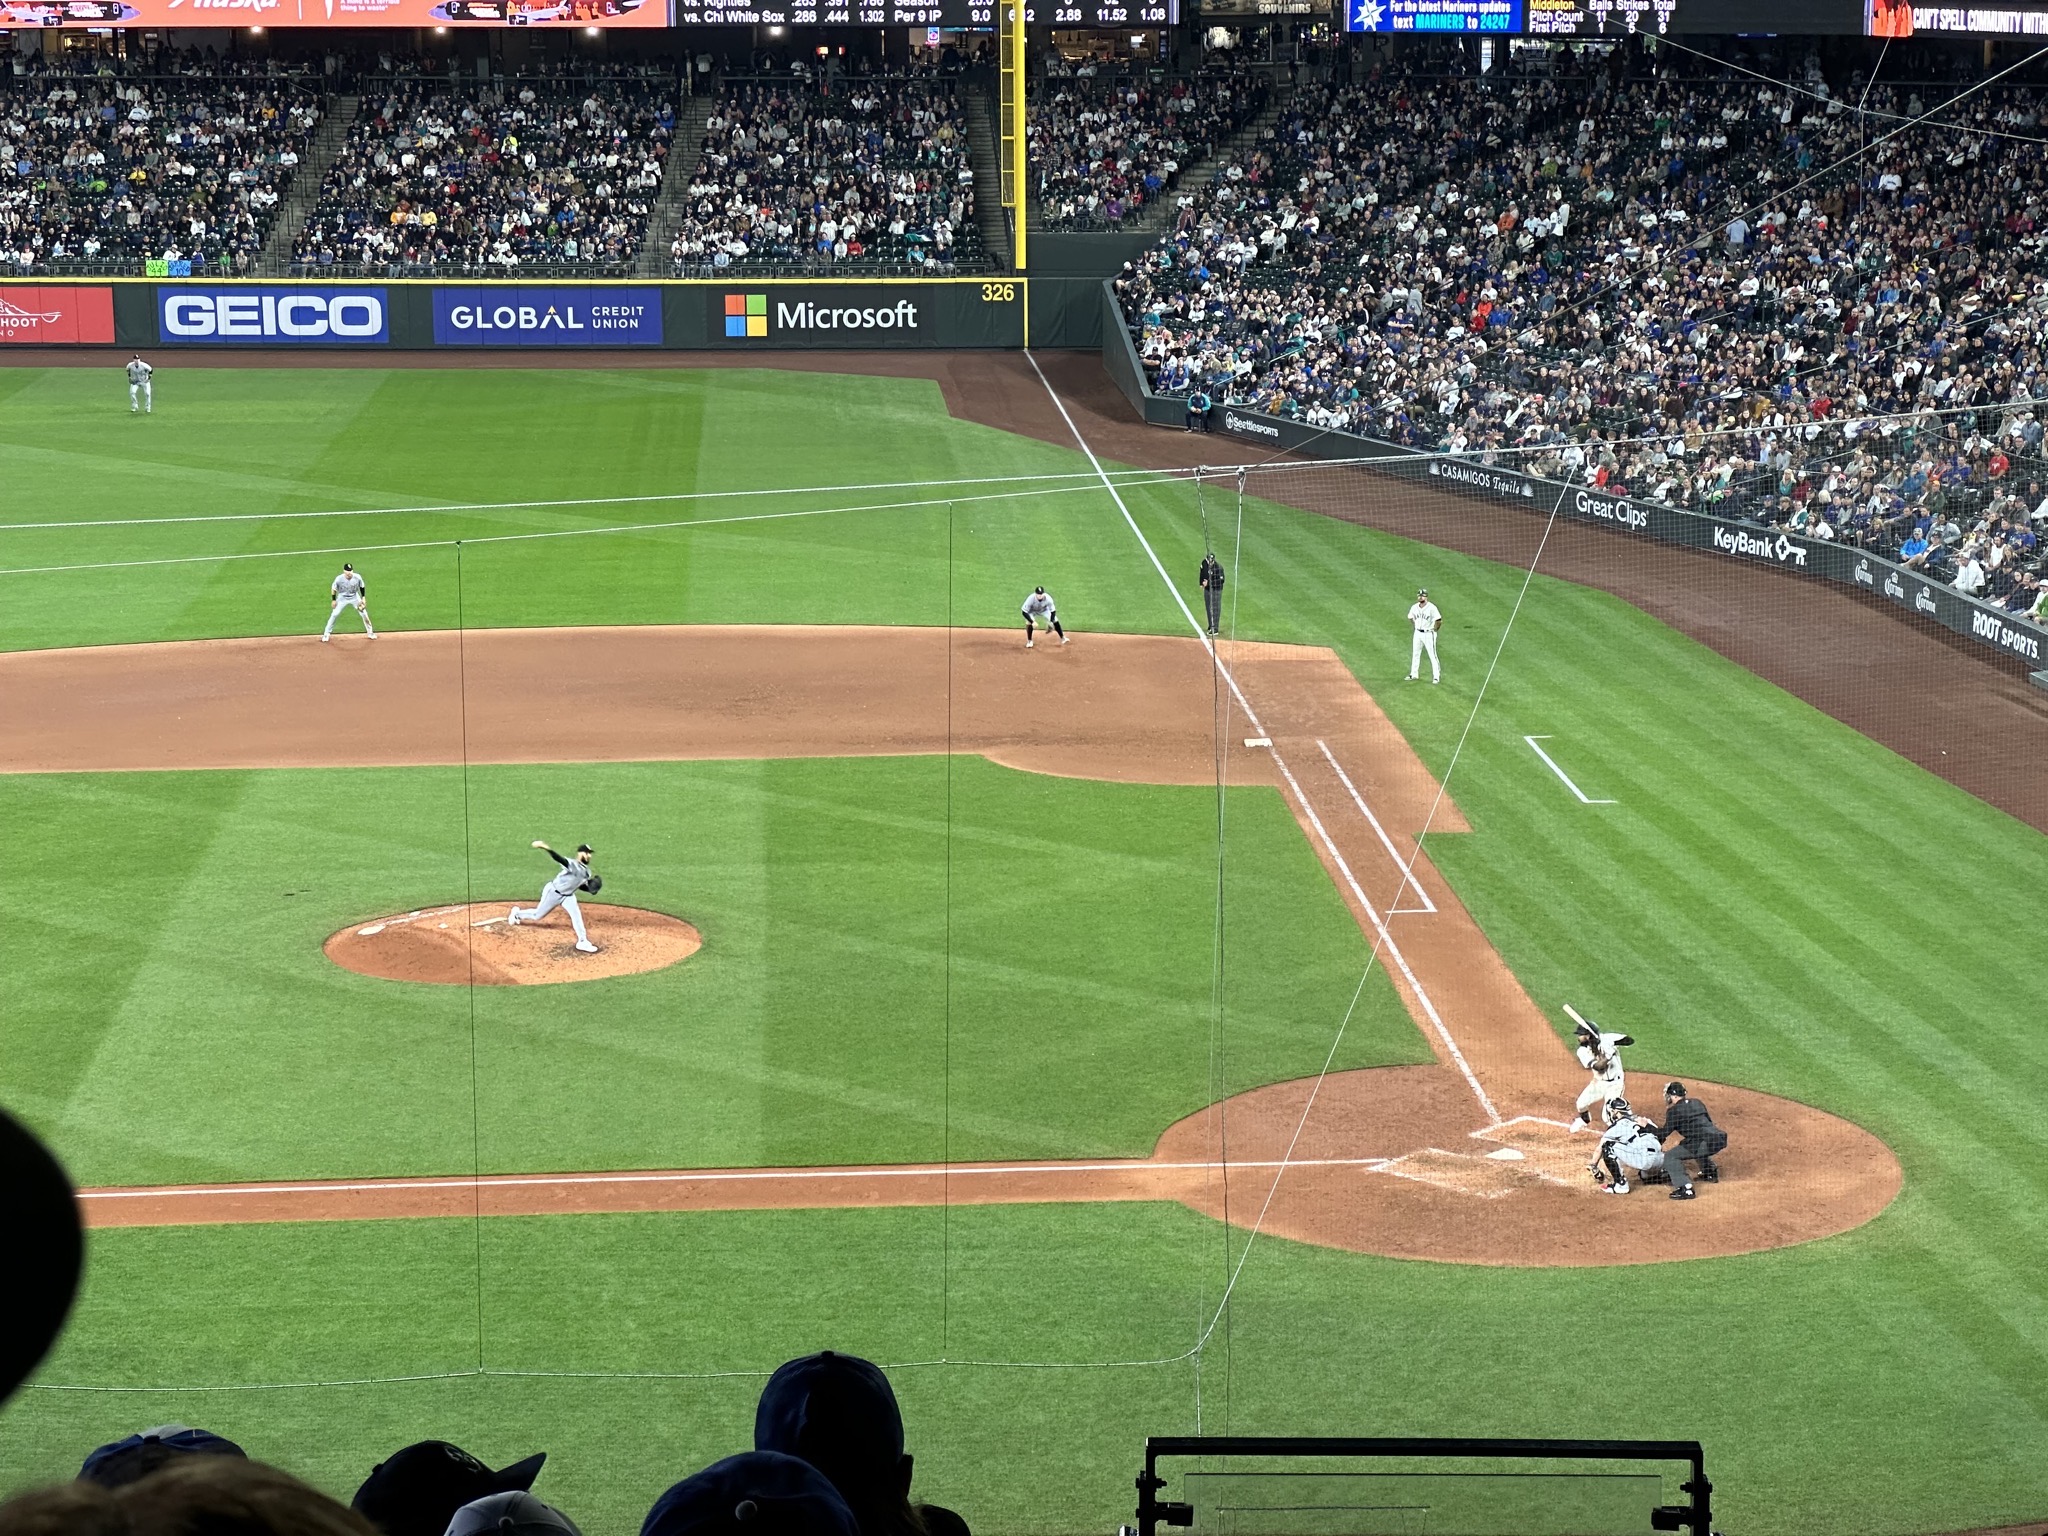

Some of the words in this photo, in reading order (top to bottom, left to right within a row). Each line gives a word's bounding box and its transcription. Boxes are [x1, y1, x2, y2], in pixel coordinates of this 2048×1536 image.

[1258, 3, 1311, 14] SOUVENIRS
[1390, 1, 1403, 12] For
[1404, 1, 1417, 12] the
[1418, 1, 1441, 12] latest
[1442, 2, 1478, 13] Mariners
[1479, 2, 1511, 15] updates
[1529, 0, 1575, 10] Middleton
[1589, 0, 1613, 10] Balls
[1616, 0, 1650, 10] Strikes
[1653, 0, 1677, 10] Total
[684, 13, 701, 23] vs.
[704, 11, 725, 23] Chi
[726, 11, 760, 23] White
[762, 10, 785, 23] Sox
[791, 11, 817, 23] .286
[825, 11, 849, 22] .444
[859, 11, 885, 22] 1.302
[894, 11, 915, 22] Per
[917, 11, 926, 22] 9
[929, 11, 943, 22] IP
[971, 10, 991, 22] 9.0
[1055, 9, 1082, 21] 2.88
[1096, 9, 1127, 21] 11.52
[1140, 9, 1165, 21] 1.08
[1393, 15, 1414, 28] text
[1415, 14, 1465, 29] MARINERS
[1467, 16, 1478, 29] to
[1480, 14, 1510, 29] 24247
[1529, 10, 1553, 21] Pitch
[1555, 11, 1583, 22] Count
[1597, 11, 1607, 22] 11
[1626, 11, 1639, 22] 20
[1657, 11, 1670, 22] 31
[1913, 8, 1939, 30] CAN'T
[1939, 8, 1967, 31] SPELL
[1967, 9, 2022, 33] COMMUNITY
[2022, 11, 2048, 34] WITH
[1529, 21, 1550, 33] First
[1552, 21, 1576, 33] Pitch
[1598, 22, 1605, 33] 1
[1628, 22, 1636, 34] 5
[1658, 22, 1667, 34] 6
[151, 268, 163, 277] 44
[176, 268, 185, 276] 10
[981, 283, 1015, 302] 326
[164, 295, 383, 336] GEICO
[451, 305, 584, 329] GLOBAL
[592, 306, 644, 317] CREDIT
[777, 299, 918, 329] Microsoft
[592, 319, 639, 329] UNION
[1441, 463, 1491, 489] CASAMIGOS
[1492, 477, 1521, 496] Tequila
[1576, 490, 1613, 520] Great
[1615, 499, 1649, 530] Clips
[1714, 526, 1774, 559] KeyBank
[1855, 563, 1874, 585] Corona
[1884, 577, 1905, 599] Corona
[1915, 590, 1937, 614] Corona
[1972, 609, 2003, 643] ROOT
